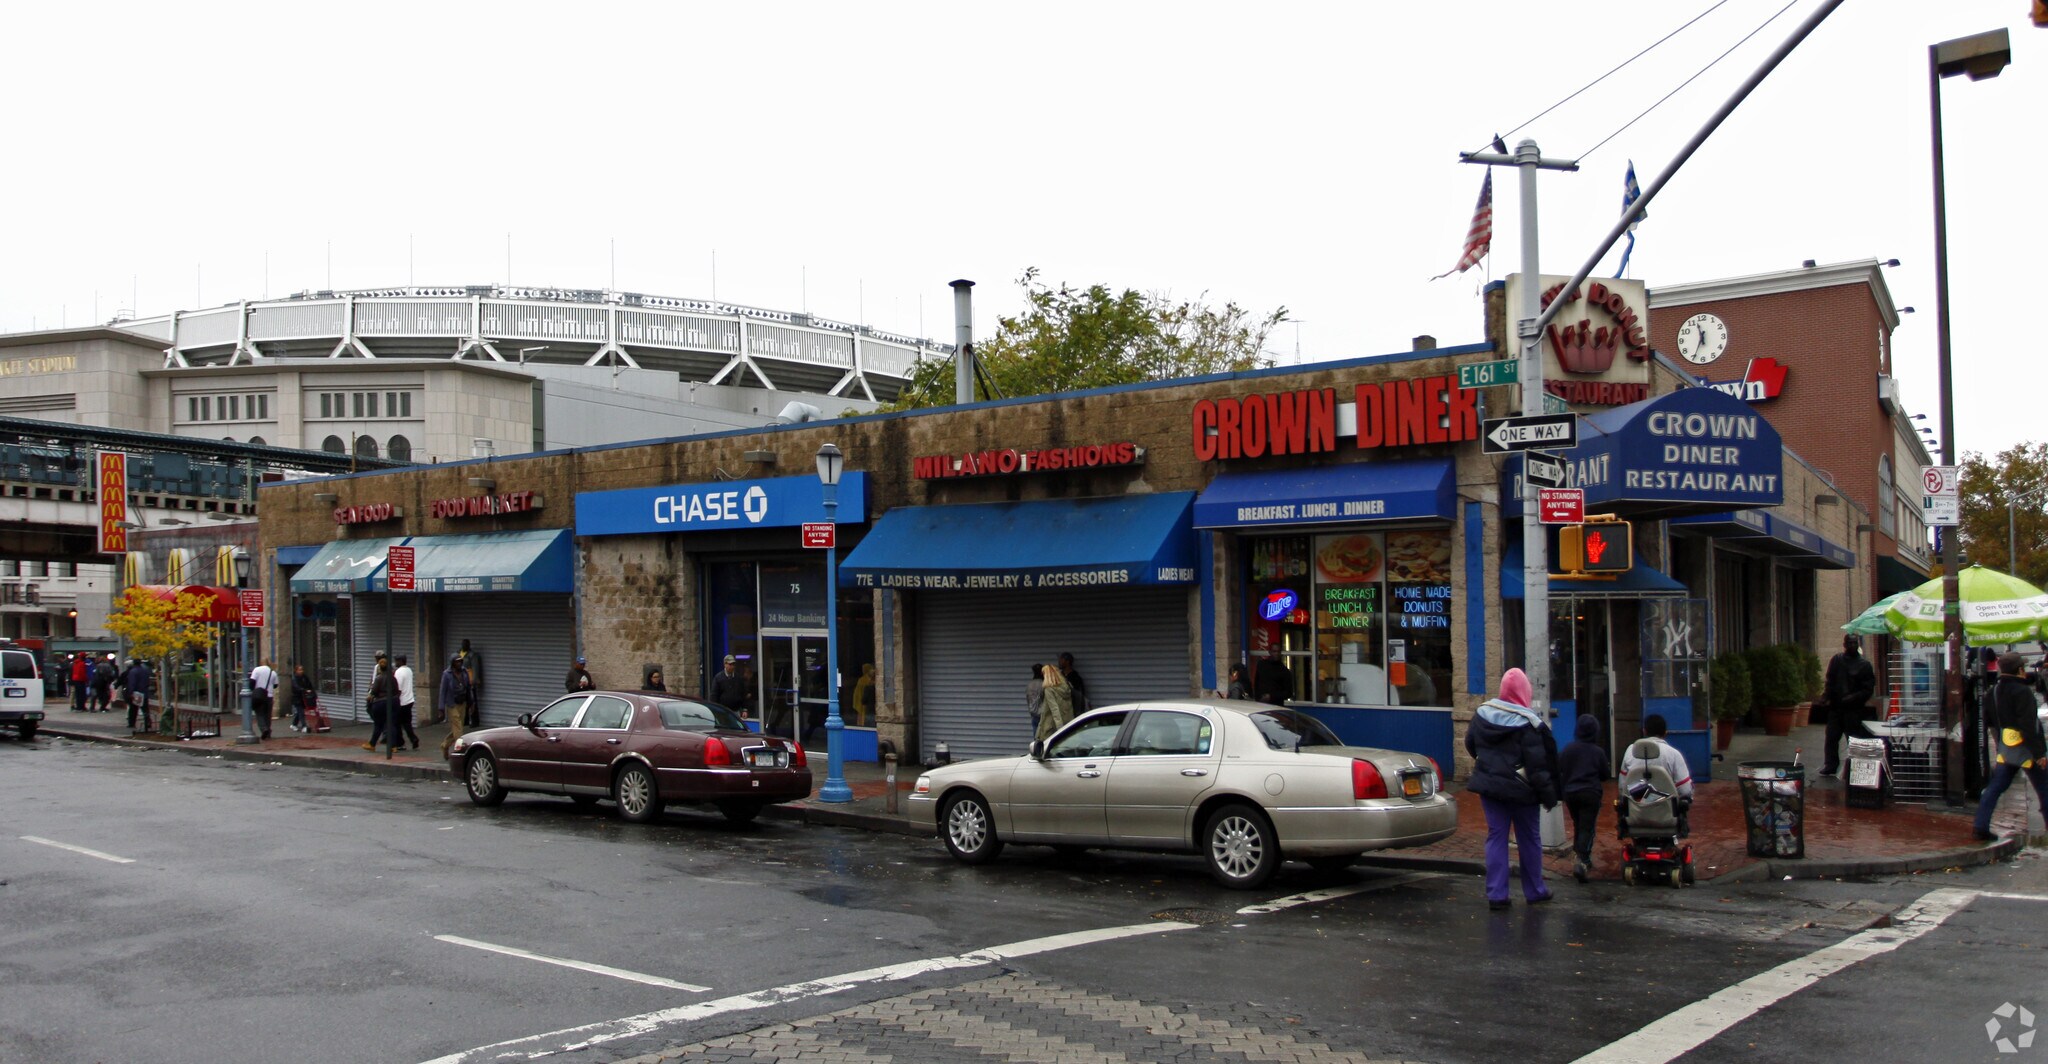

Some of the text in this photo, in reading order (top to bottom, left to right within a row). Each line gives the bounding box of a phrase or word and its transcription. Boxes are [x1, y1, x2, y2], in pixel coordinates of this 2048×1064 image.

[1588, 283, 1649, 362] DONUT
[28, 356, 76, 374] STADIUM
[1462, 363, 1515, 386] E 161 ST
[1192, 374, 1478, 462] CROWN DINER
[1647, 412, 1757, 440] CROWN
[1500, 424, 1562, 442] ONE WAY
[914, 442, 1137, 480] MILANO FASHIONS
[1664, 444, 1740, 466] DINER
[1532, 462, 1561, 480] ONE WAY
[1626, 469, 1777, 494] RESTAURANT
[430, 497, 466, 519] FOOD
[469, 491, 531, 516] MARKET
[1552, 492, 1580, 500] STANDING
[654, 492, 739, 524] CHASE
[1238, 500, 1384, 521] BREAKFAST LUNCH DINNER
[856, 574, 873, 586] 77E
[881, 574, 920, 587] LADIES
[964, 575, 1019, 588] JEWELRY
[1024, 574, 1032, 587] &
[1038, 570, 1128, 587] ACCESSORIES
[1158, 568, 1194, 581] LADIES WEAR
[790, 583, 800, 594] 75
[1325, 588, 1376, 600] BREAKFAST
[1395, 586, 1451, 599] HOME MADE
[1328, 602, 1373, 614] LUNCH &
[1404, 601, 1443, 613] DONUTS
[768, 614, 826, 625] 24 Hour Banking
[1332, 616, 1369, 628] DINNER
[1400, 616, 1447, 628] & MUFFIN
[1998, 631, 2023, 639] FOOD
